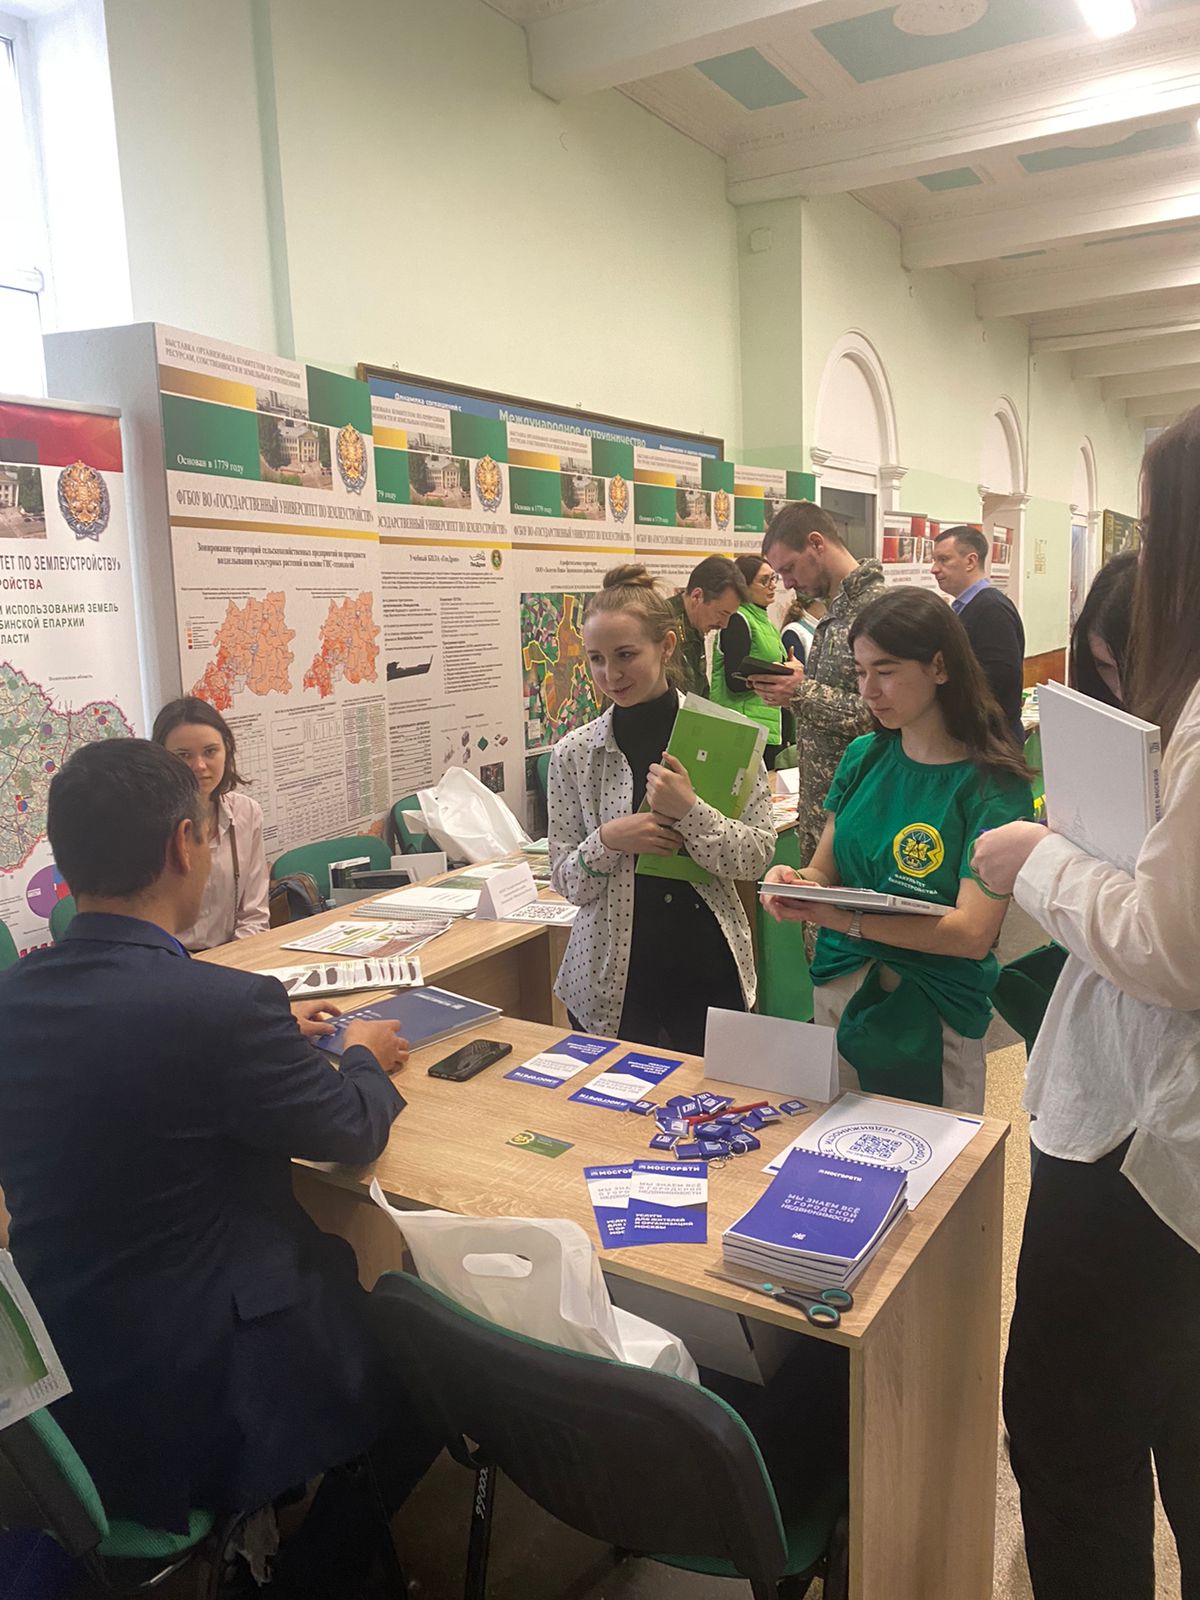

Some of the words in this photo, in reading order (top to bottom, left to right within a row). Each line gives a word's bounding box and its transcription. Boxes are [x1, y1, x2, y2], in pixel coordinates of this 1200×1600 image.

[177, 454, 207, 467] Основан
[215, 459, 229, 470] 1779
[230, 463, 244, 475] году
[177, 489, 201, 506] ФГБОУ
[202, 491, 213, 508] ВО
[18, 555, 31, 570] ПО
[34, 554, 121, 571] ЗЕМЛЕУСТРОЙСТВУ»
[5, 603, 85, 615] ИСПОЛЬЗОВАНИЯ
[87, 603, 119, 613] ЗЕМЕЛЬ
[43, 618, 85, 629] ЕПАРХИИ
[1, 634, 30, 644] ЛАСТИ
[646, 1164, 700, 1172] МОСГОРБТИ
[788, 1193, 804, 1201] МЫ
[806, 1197, 840, 1209] ЗНАЕМ
[781, 1204, 854, 1224] НЕДВИЖИМОСТИ
[794, 1201, 858, 1218] ГОРОДСКОЙ
